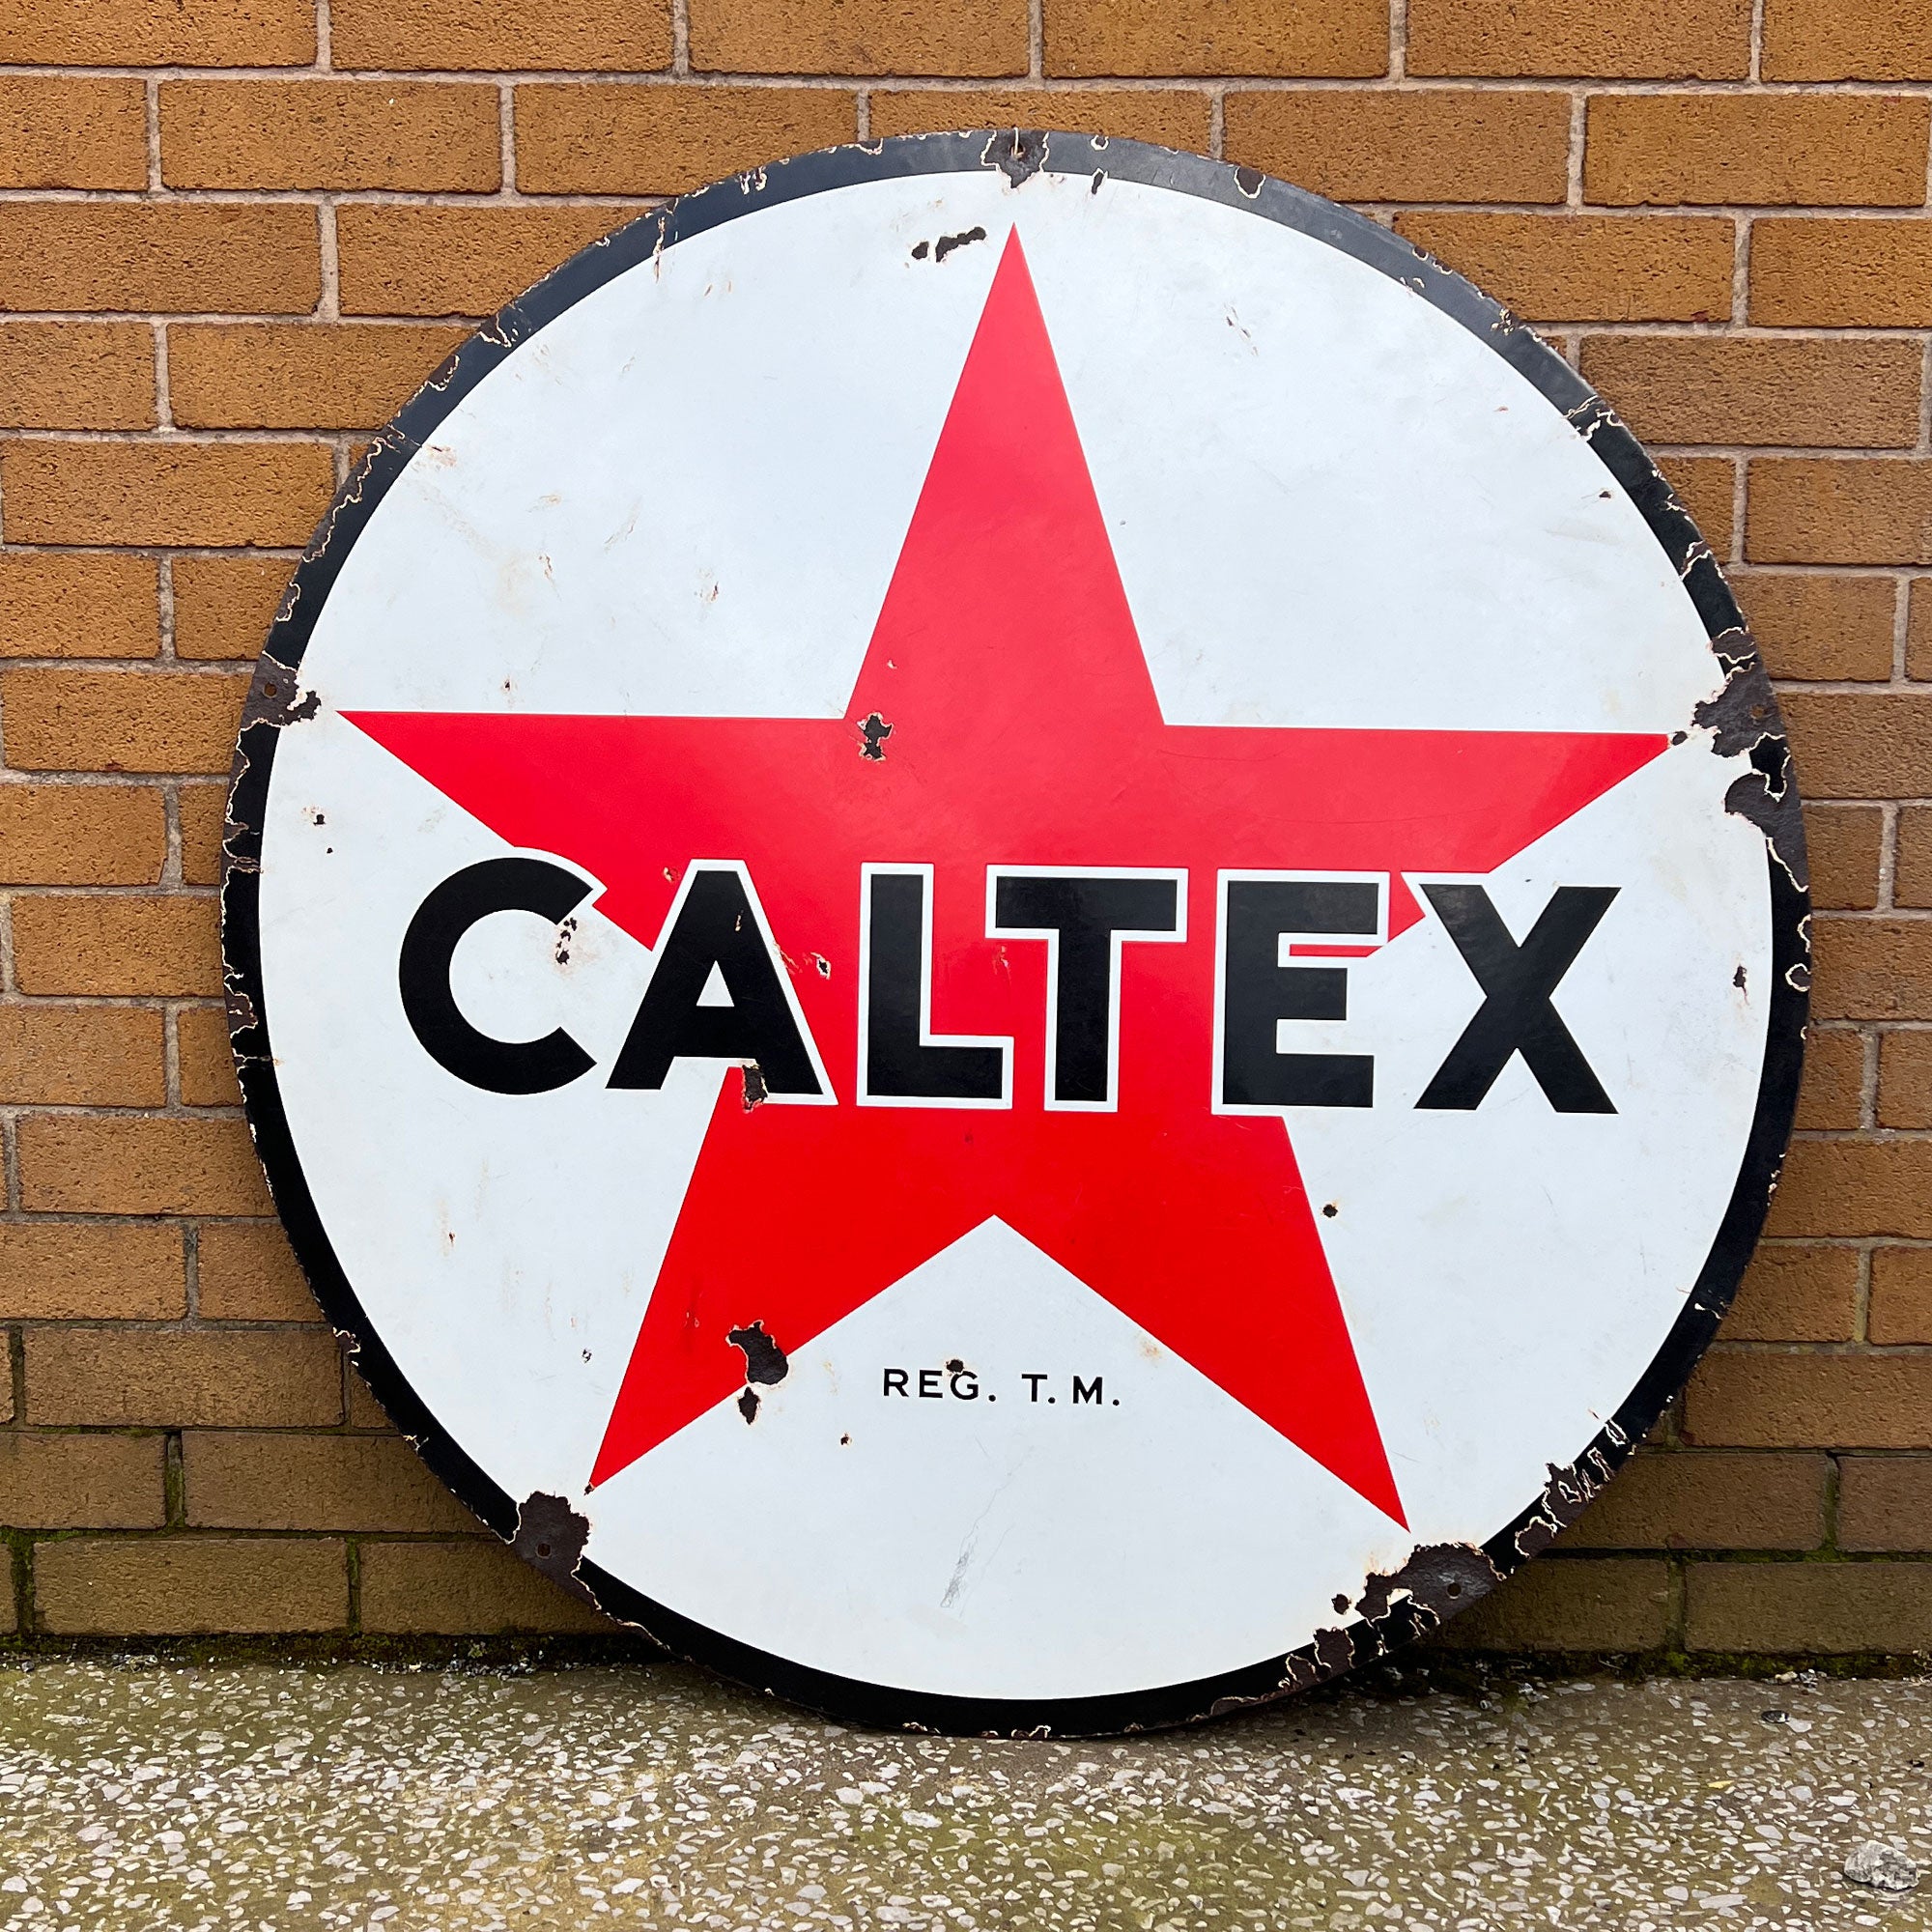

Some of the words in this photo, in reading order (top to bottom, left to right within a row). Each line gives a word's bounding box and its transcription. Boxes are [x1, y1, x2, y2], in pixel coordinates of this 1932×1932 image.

[397, 856, 1623, 1116] CALTEX
[883, 1368, 997, 1403] REG.
[1021, 1374, 1120, 1406] T.M.
